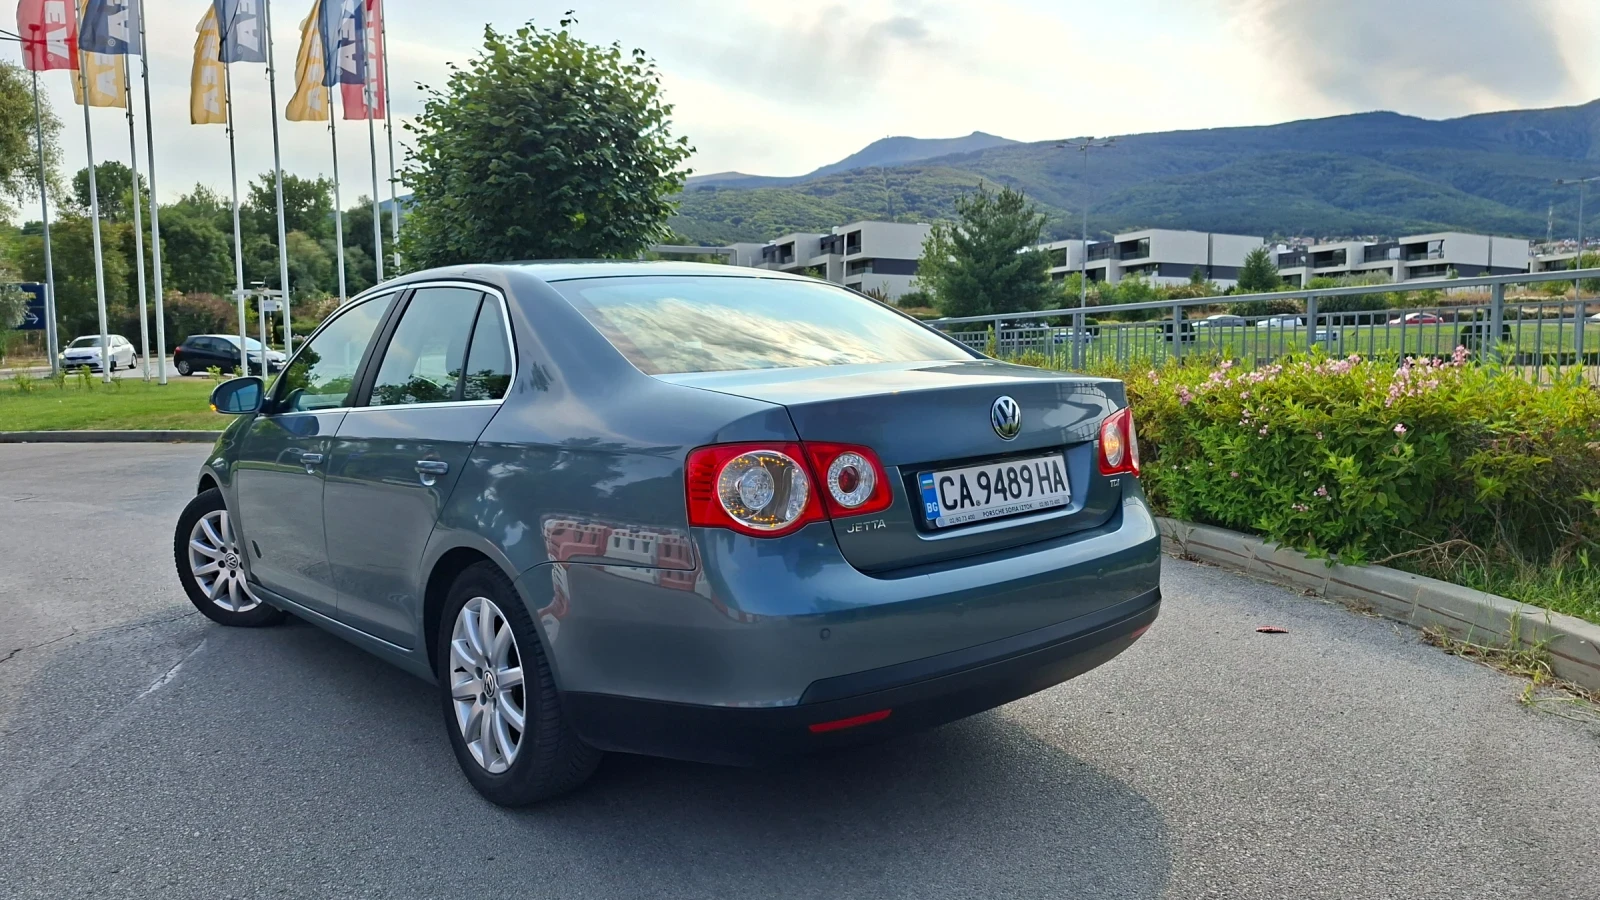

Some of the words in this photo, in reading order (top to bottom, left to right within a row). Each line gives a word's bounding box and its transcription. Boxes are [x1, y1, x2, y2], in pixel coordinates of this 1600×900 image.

[939, 473, 975, 511] CA
[976, 464, 1034, 505] 9489
[1035, 459, 1067, 495] HA
[926, 501, 939, 513] BG
[982, 508, 1005, 518] PORSCHE
[1006, 505, 1019, 514] SOFIA
[846, 519, 887, 533] JETTA
